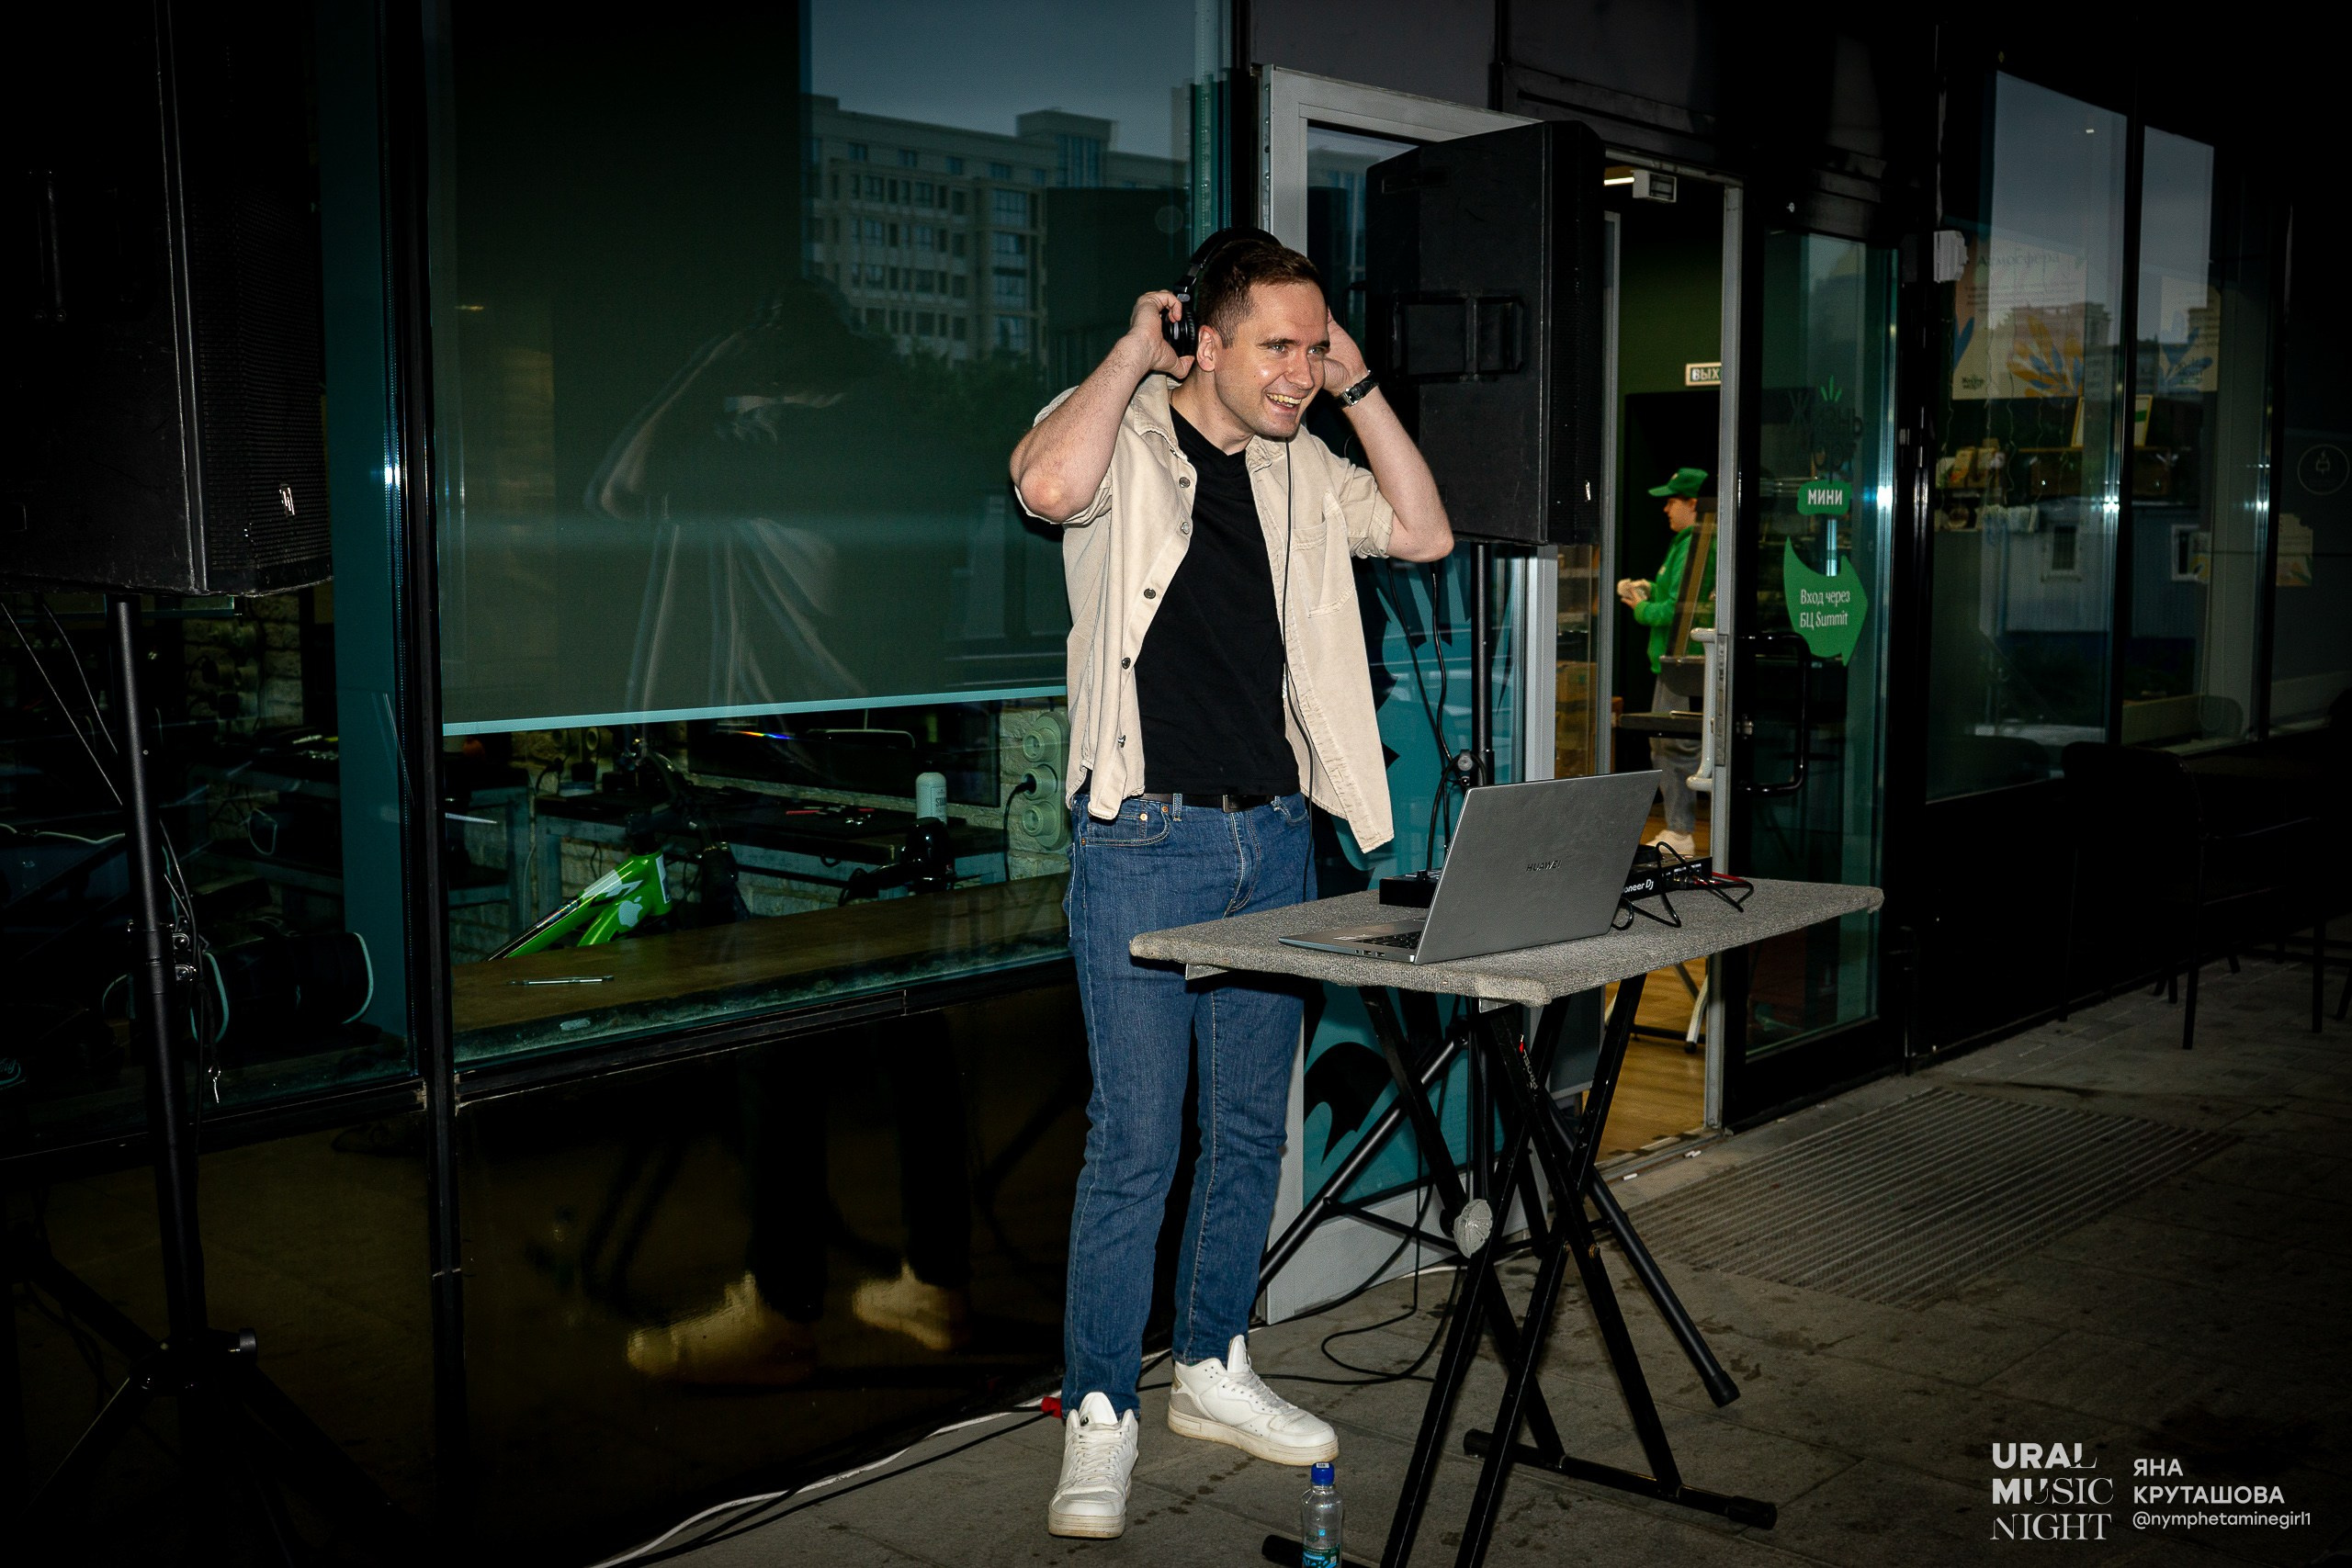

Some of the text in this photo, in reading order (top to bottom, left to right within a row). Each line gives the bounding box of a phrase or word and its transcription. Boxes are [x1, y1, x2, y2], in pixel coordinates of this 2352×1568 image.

[1691, 367, 1720, 380] ВЫХ
[1807, 489, 1843, 506] МИНИ
[1800, 589, 1851, 607] Вход через
[1800, 610, 1849, 630] БЦ Summit
[1526, 860, 1562, 872] HUAWEI
[1622, 882, 1645, 894] oneer
